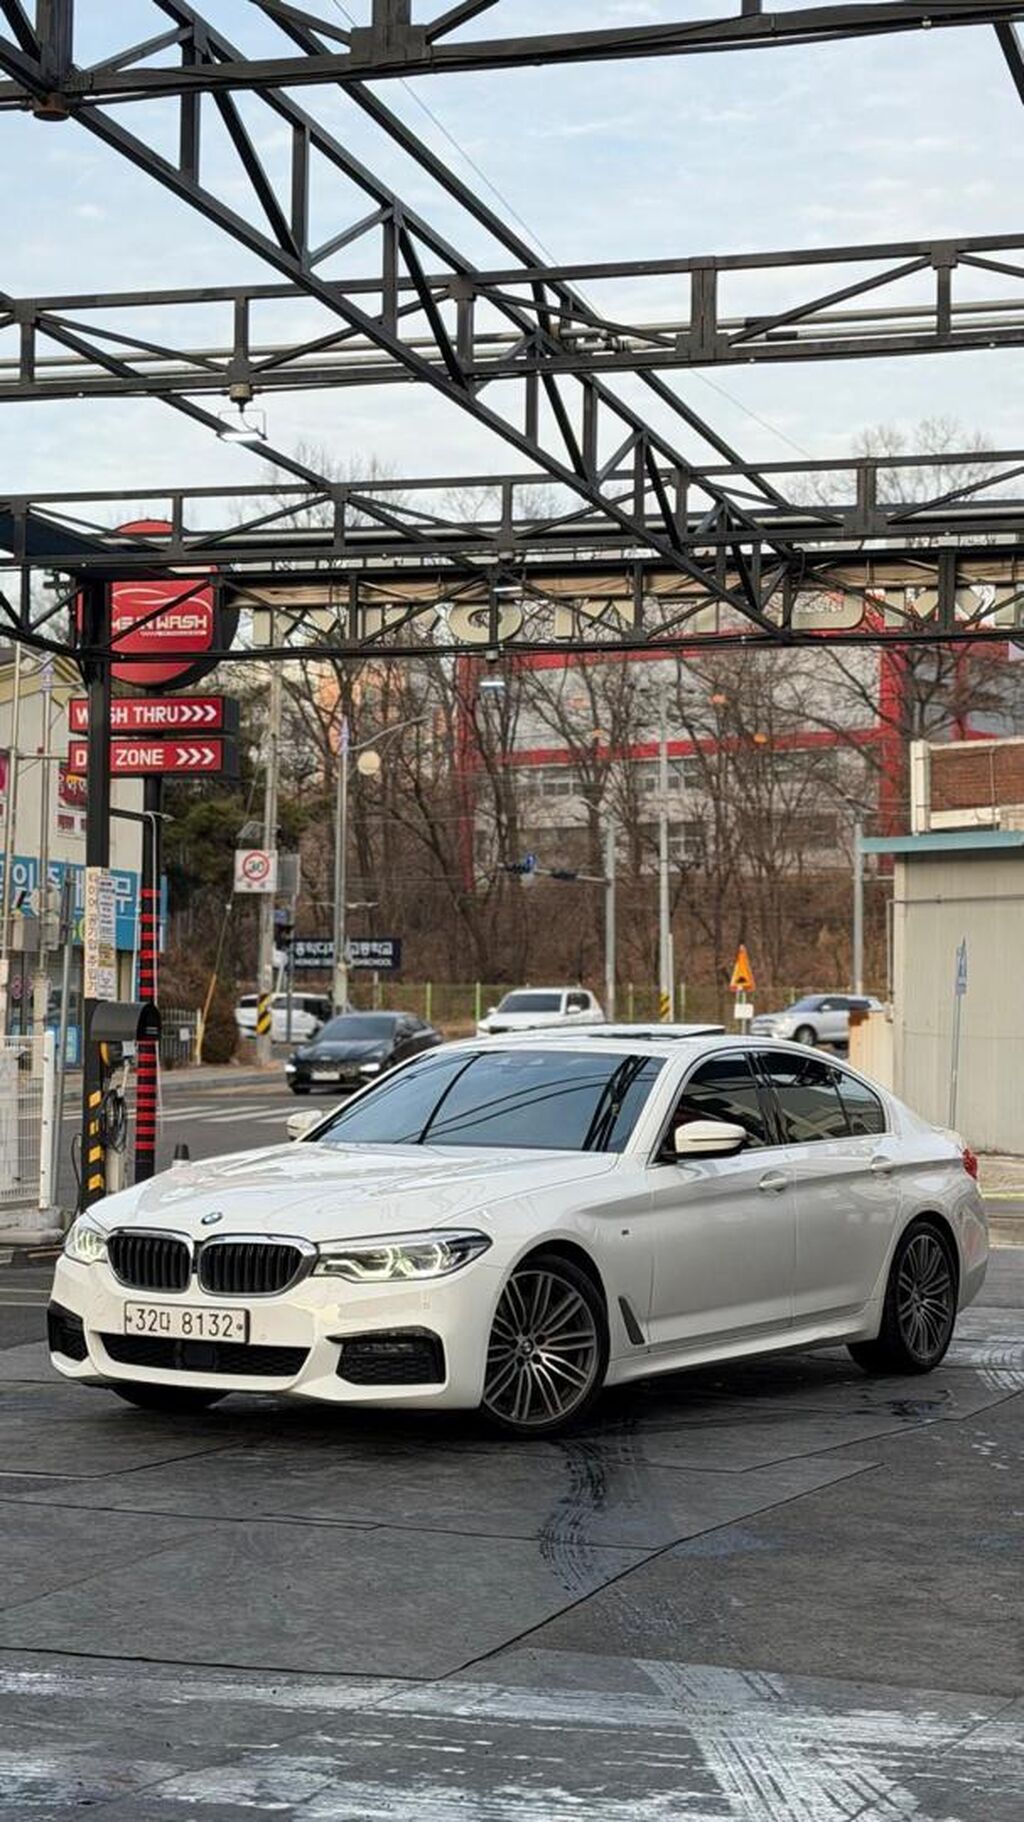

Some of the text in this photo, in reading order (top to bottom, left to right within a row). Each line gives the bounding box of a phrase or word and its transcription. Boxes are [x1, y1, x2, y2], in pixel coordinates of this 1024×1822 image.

[156, 615, 207, 629] WASH
[76, 706, 179, 724] WSH THRU
[115, 749, 164, 767] ZONE
[181, 1311, 233, 1338] 8132
